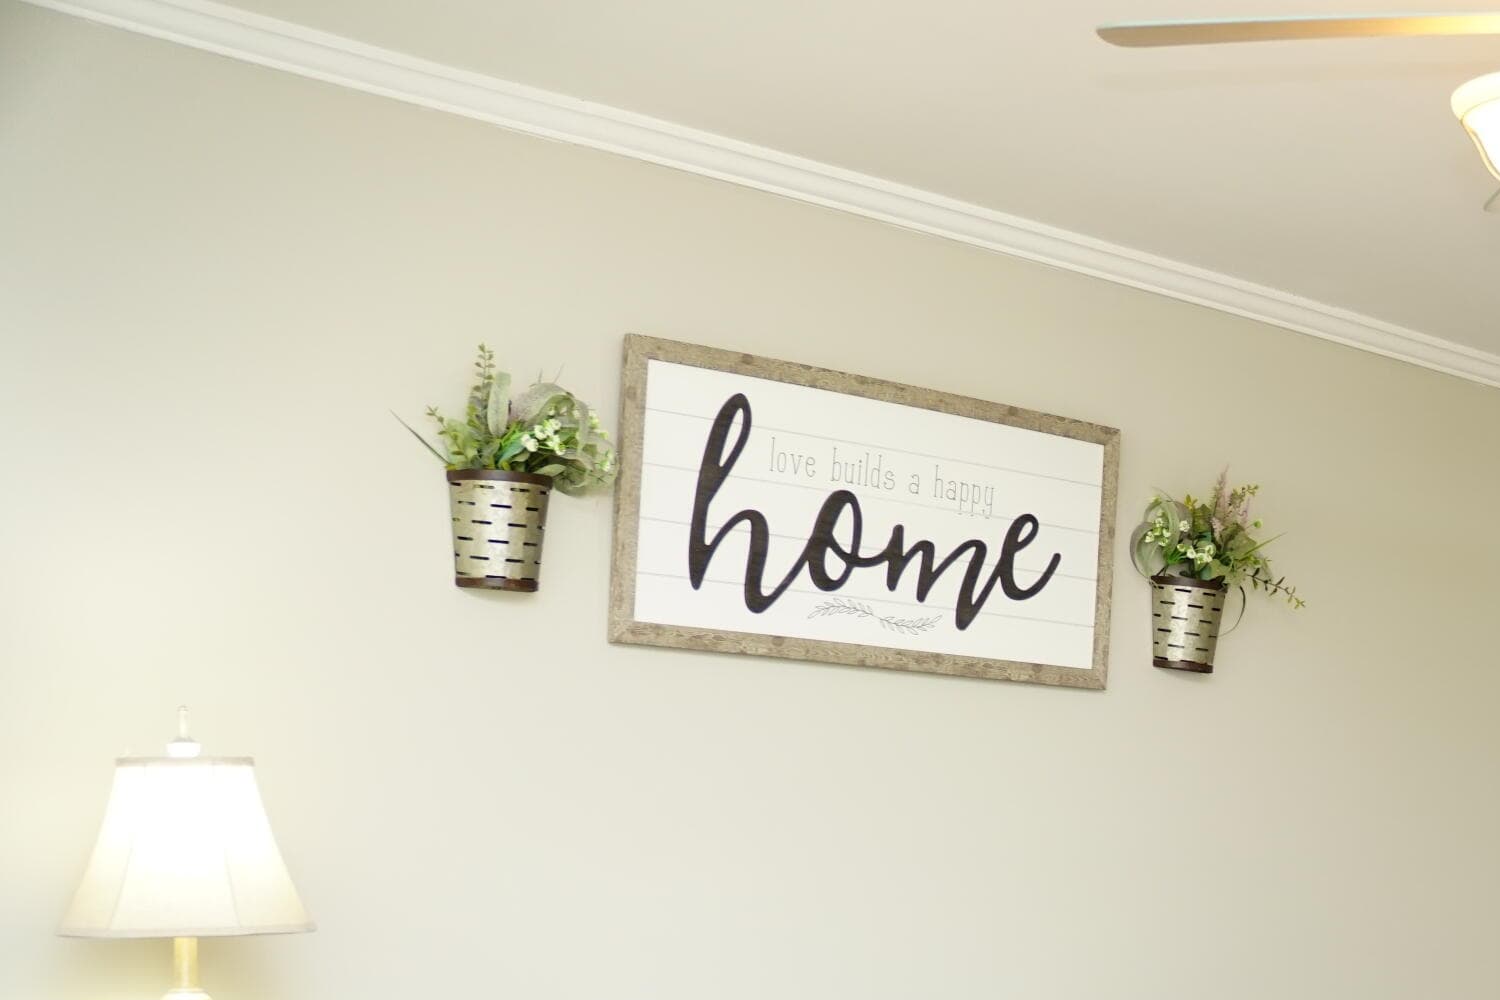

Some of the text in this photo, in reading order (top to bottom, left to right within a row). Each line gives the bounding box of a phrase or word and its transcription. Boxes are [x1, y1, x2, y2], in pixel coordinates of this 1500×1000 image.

[688, 392, 1062, 632] home
[768, 436, 995, 519] love builds a happy
